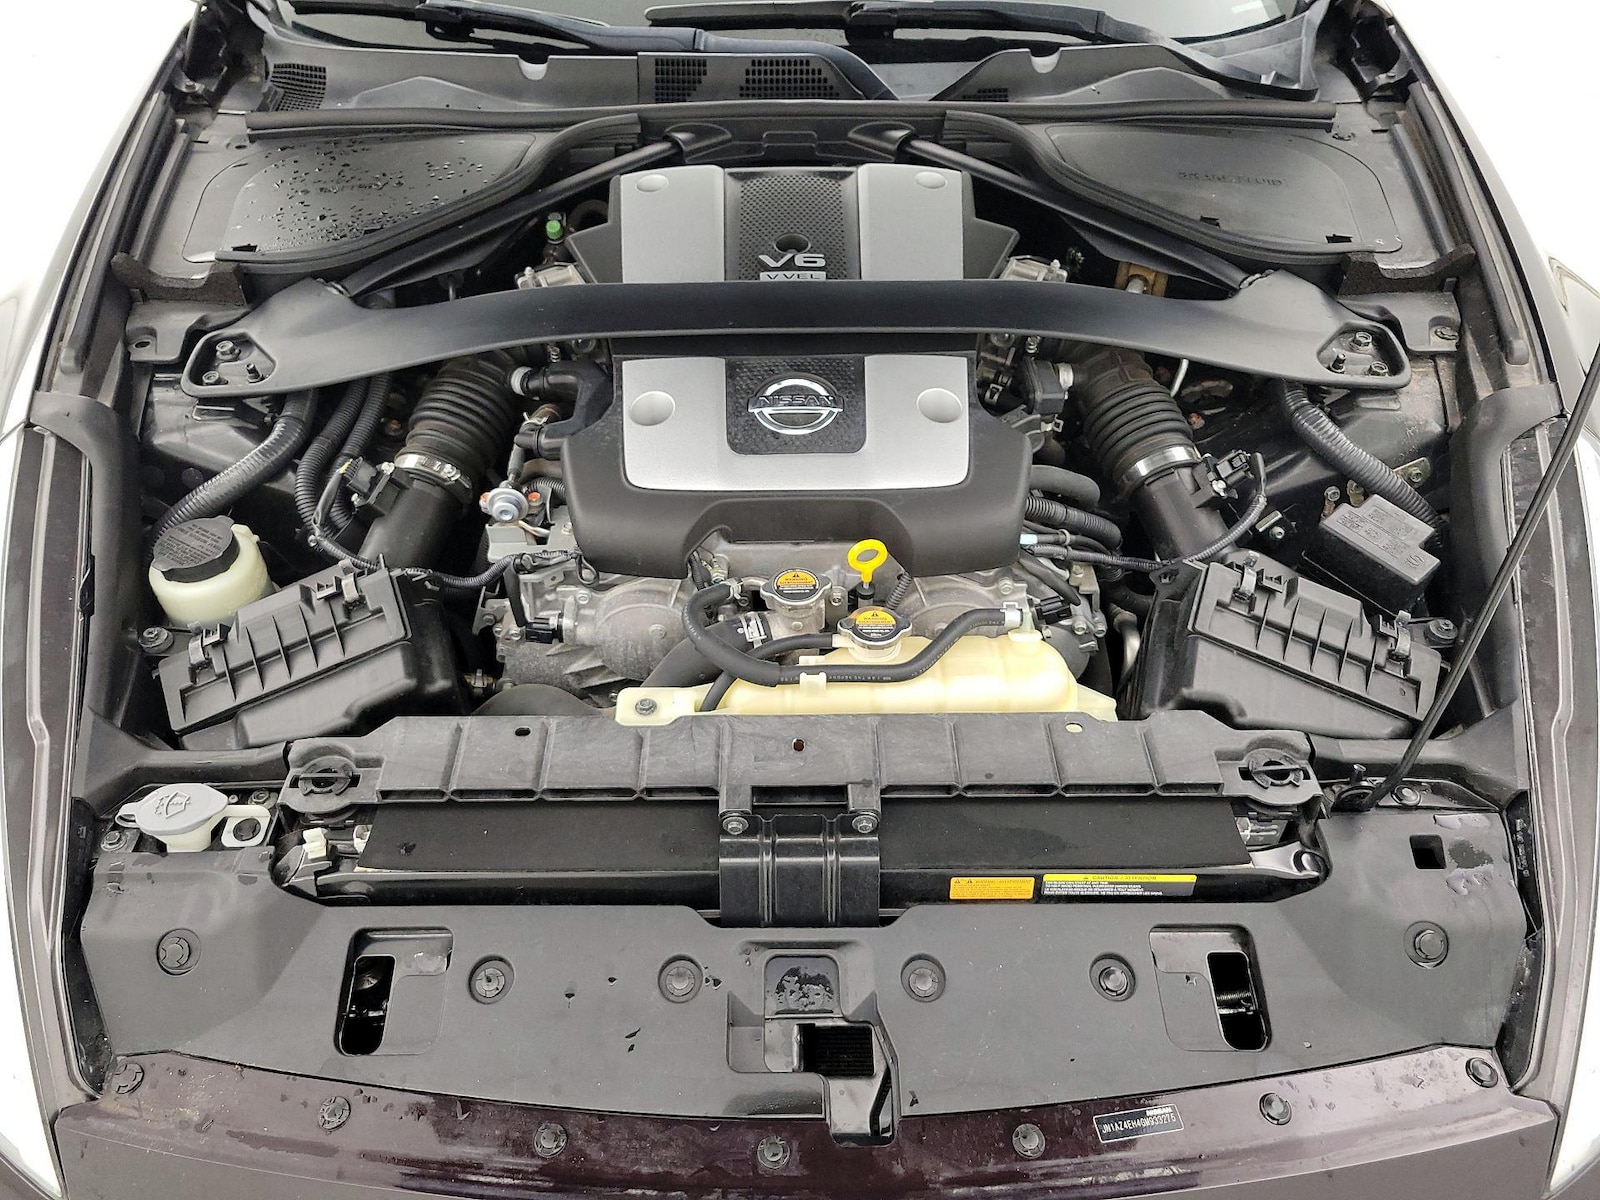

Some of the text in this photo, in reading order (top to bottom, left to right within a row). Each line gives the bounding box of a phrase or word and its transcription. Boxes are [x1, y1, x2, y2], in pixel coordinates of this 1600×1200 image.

[759, 253, 826, 268] V6
[758, 395, 834, 407] NISSAN
[1146, 1107, 1173, 1116] NISSAN
